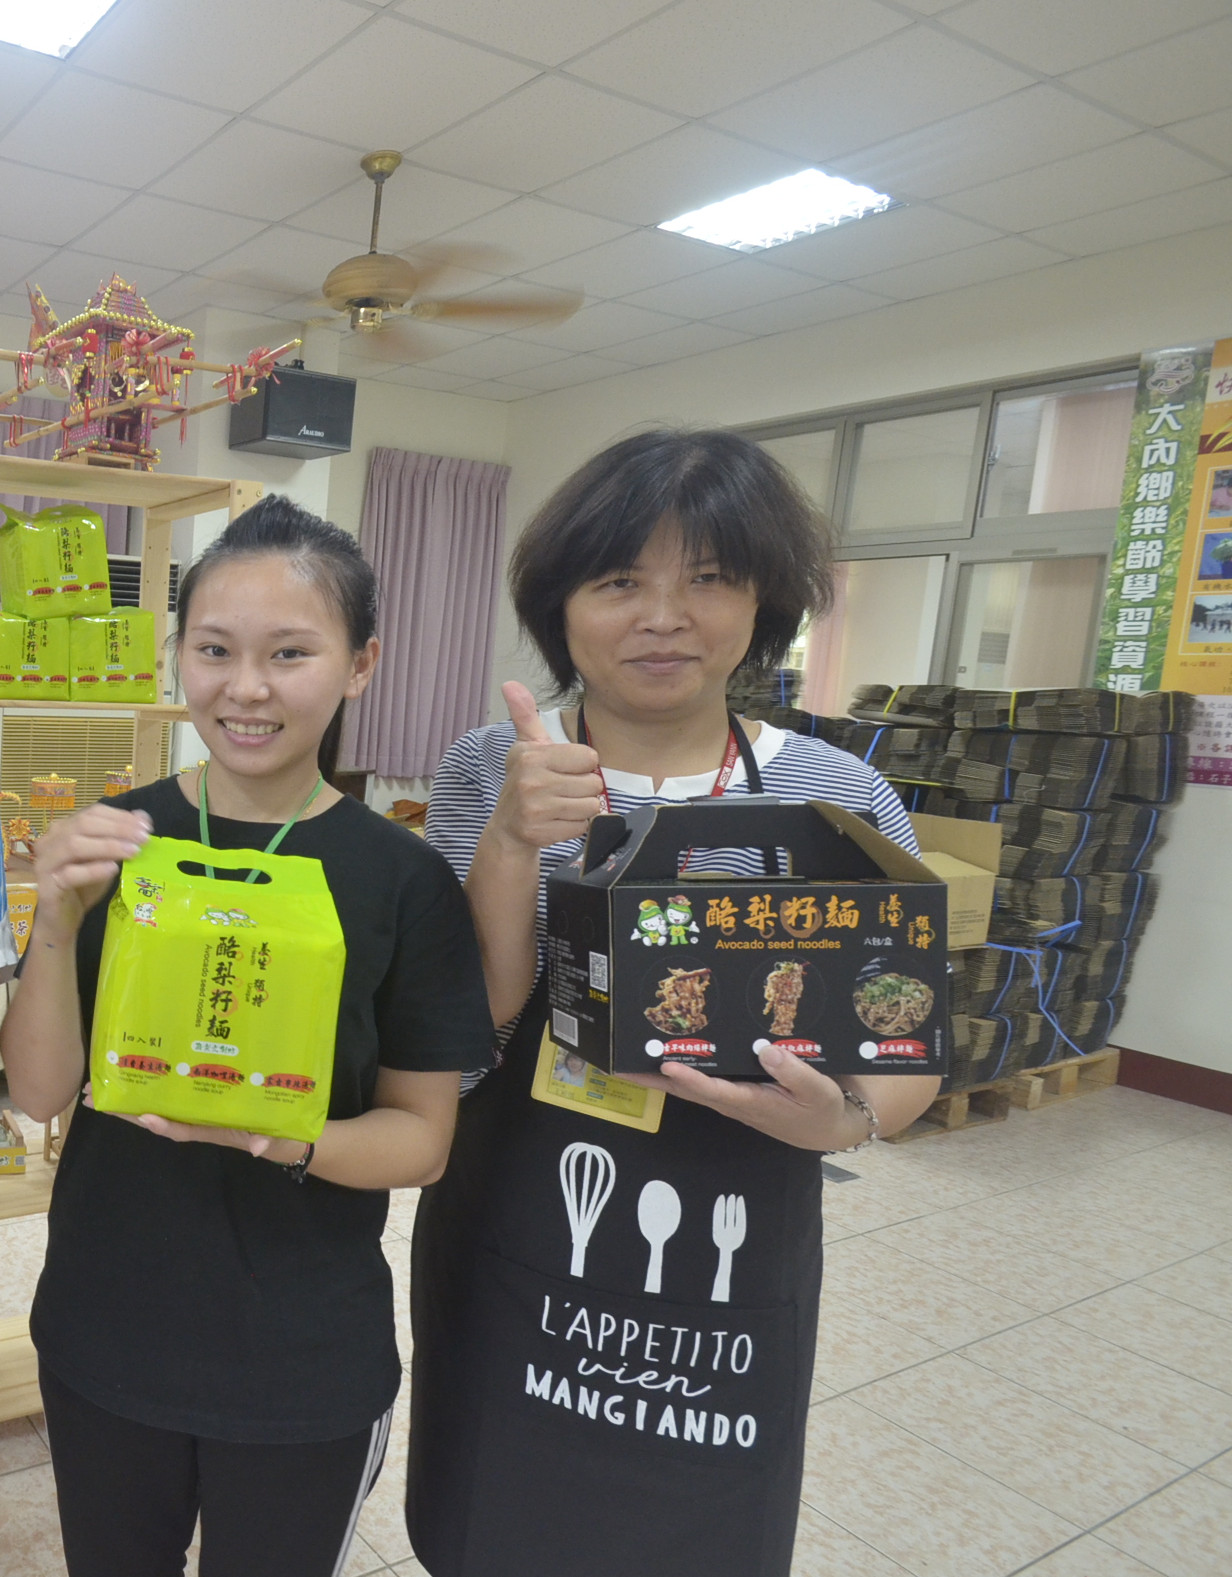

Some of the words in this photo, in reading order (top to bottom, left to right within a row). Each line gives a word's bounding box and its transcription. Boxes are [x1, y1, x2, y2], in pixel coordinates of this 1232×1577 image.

[706, 894, 859, 930] 酪梨籽麵
[716, 939, 764, 950] Avocado
[768, 939, 794, 950] seed
[797, 939, 841, 950] noodles
[206, 936, 240, 1039] 酪梨籽麵
[542, 1295, 753, 1374] L'APPETITO
[525, 1364, 757, 1448] MANGIANDO
[578, 1357, 711, 1397] vien
